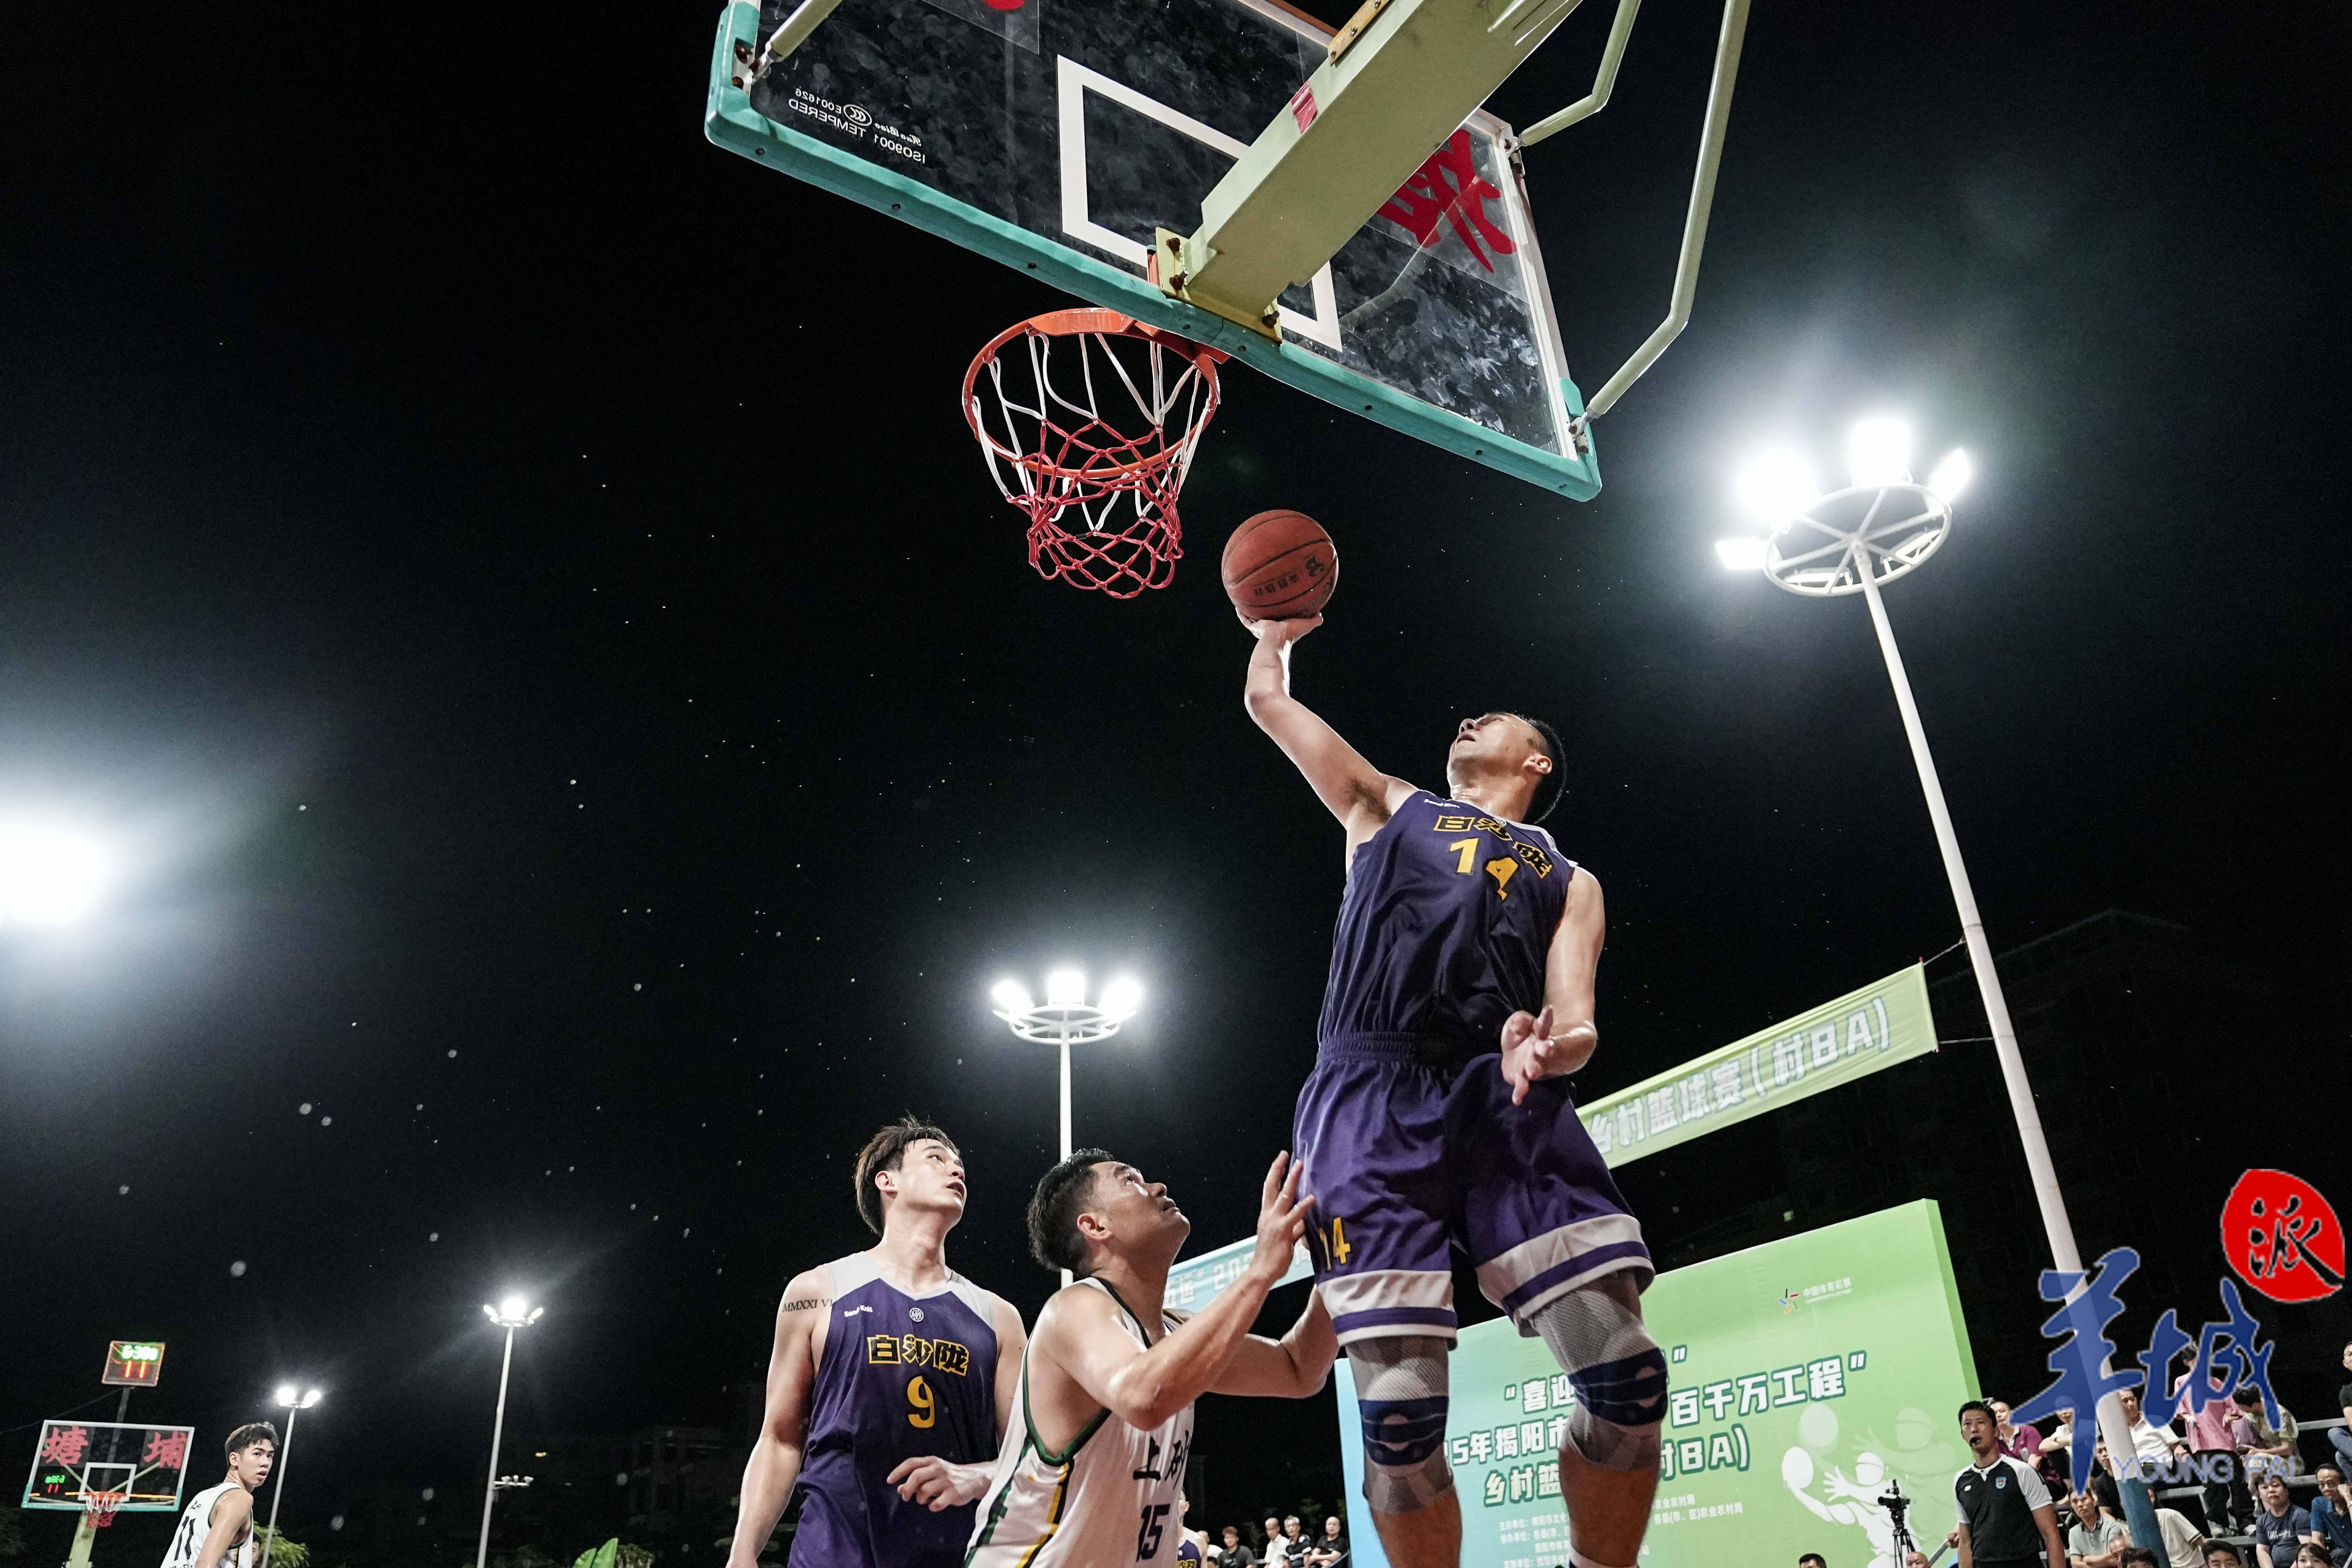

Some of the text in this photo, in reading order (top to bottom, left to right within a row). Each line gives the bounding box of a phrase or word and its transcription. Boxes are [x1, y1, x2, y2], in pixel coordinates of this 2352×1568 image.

[783, 1299, 818, 1313] MMXXI
[125, 1360, 146, 1379] 11
[906, 1375, 935, 1429] 9
[1445, 1413, 1569, 1466] 5年揭阳市
[174, 1516, 196, 1561] 11
[1135, 1503, 1171, 1563] 15
